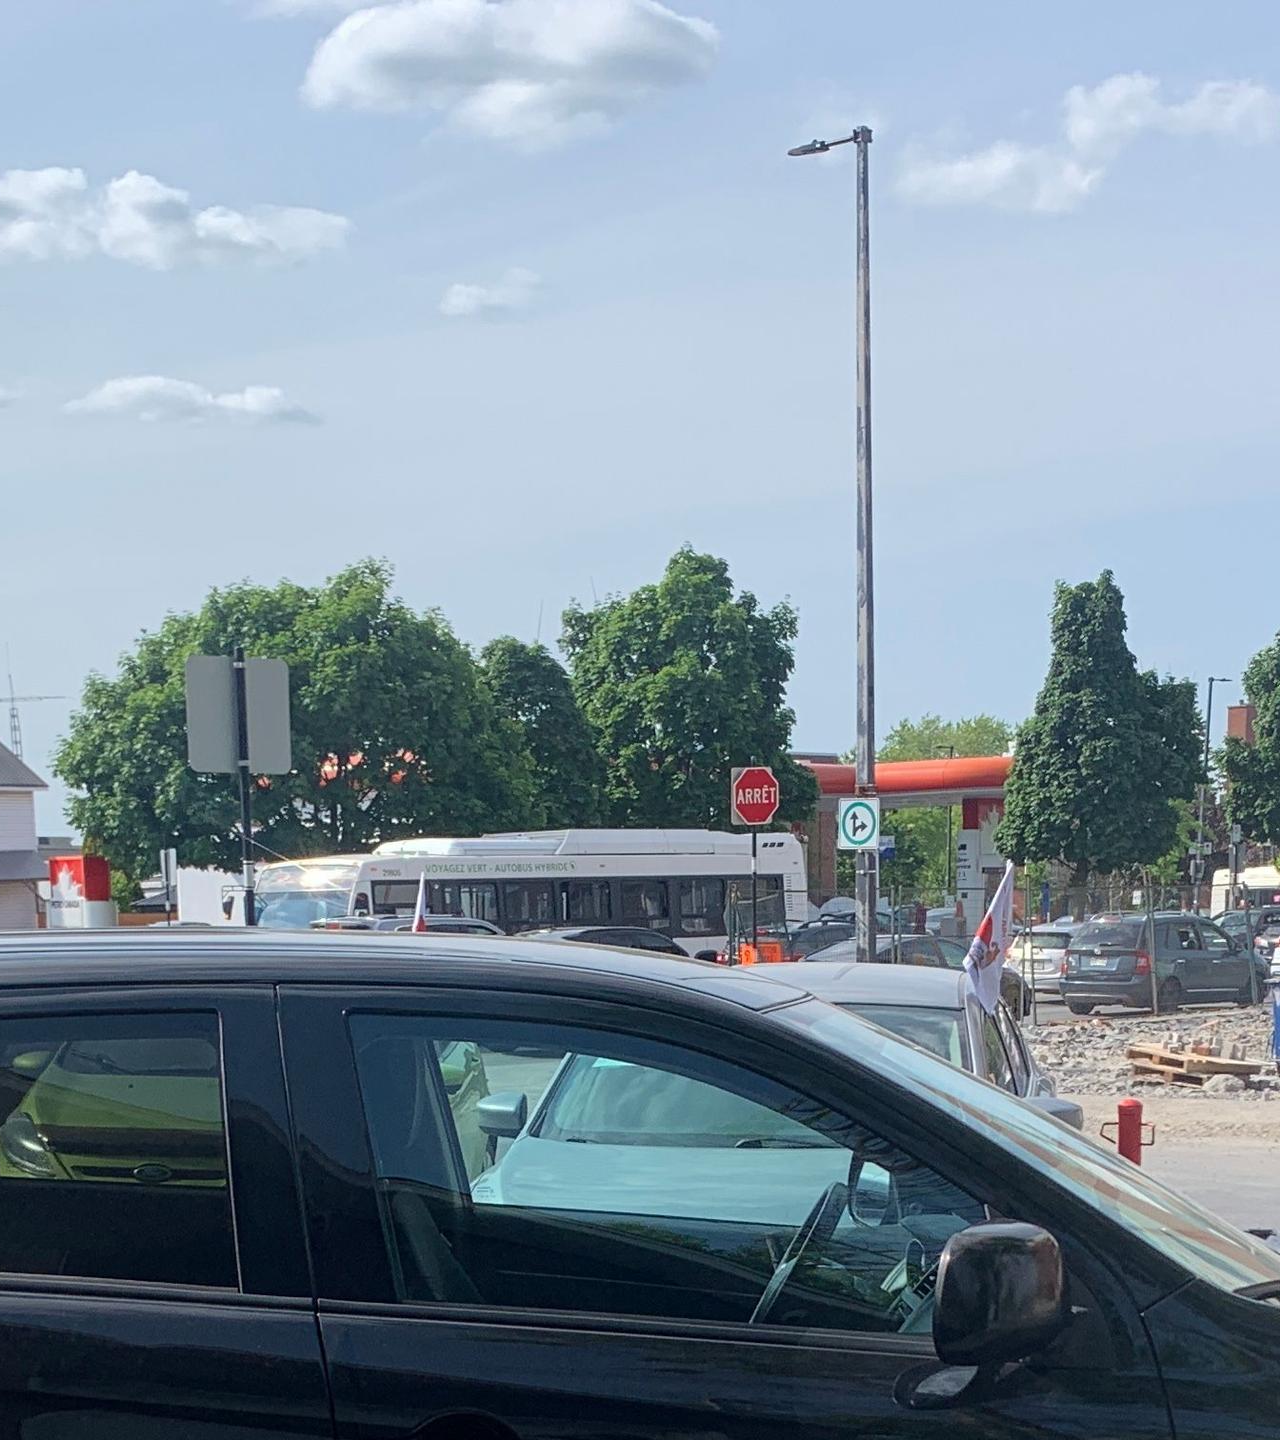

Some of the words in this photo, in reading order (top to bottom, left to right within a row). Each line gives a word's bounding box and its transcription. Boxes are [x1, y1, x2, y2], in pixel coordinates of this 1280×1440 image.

[737, 785, 776, 805] ARRÊT
[424, 863, 465, 873] VOYAGEZ
[467, 863, 487, 873] VERT
[495, 862, 533, 873] AUTOBUS
[534, 861, 568, 872] HYBRIDE
